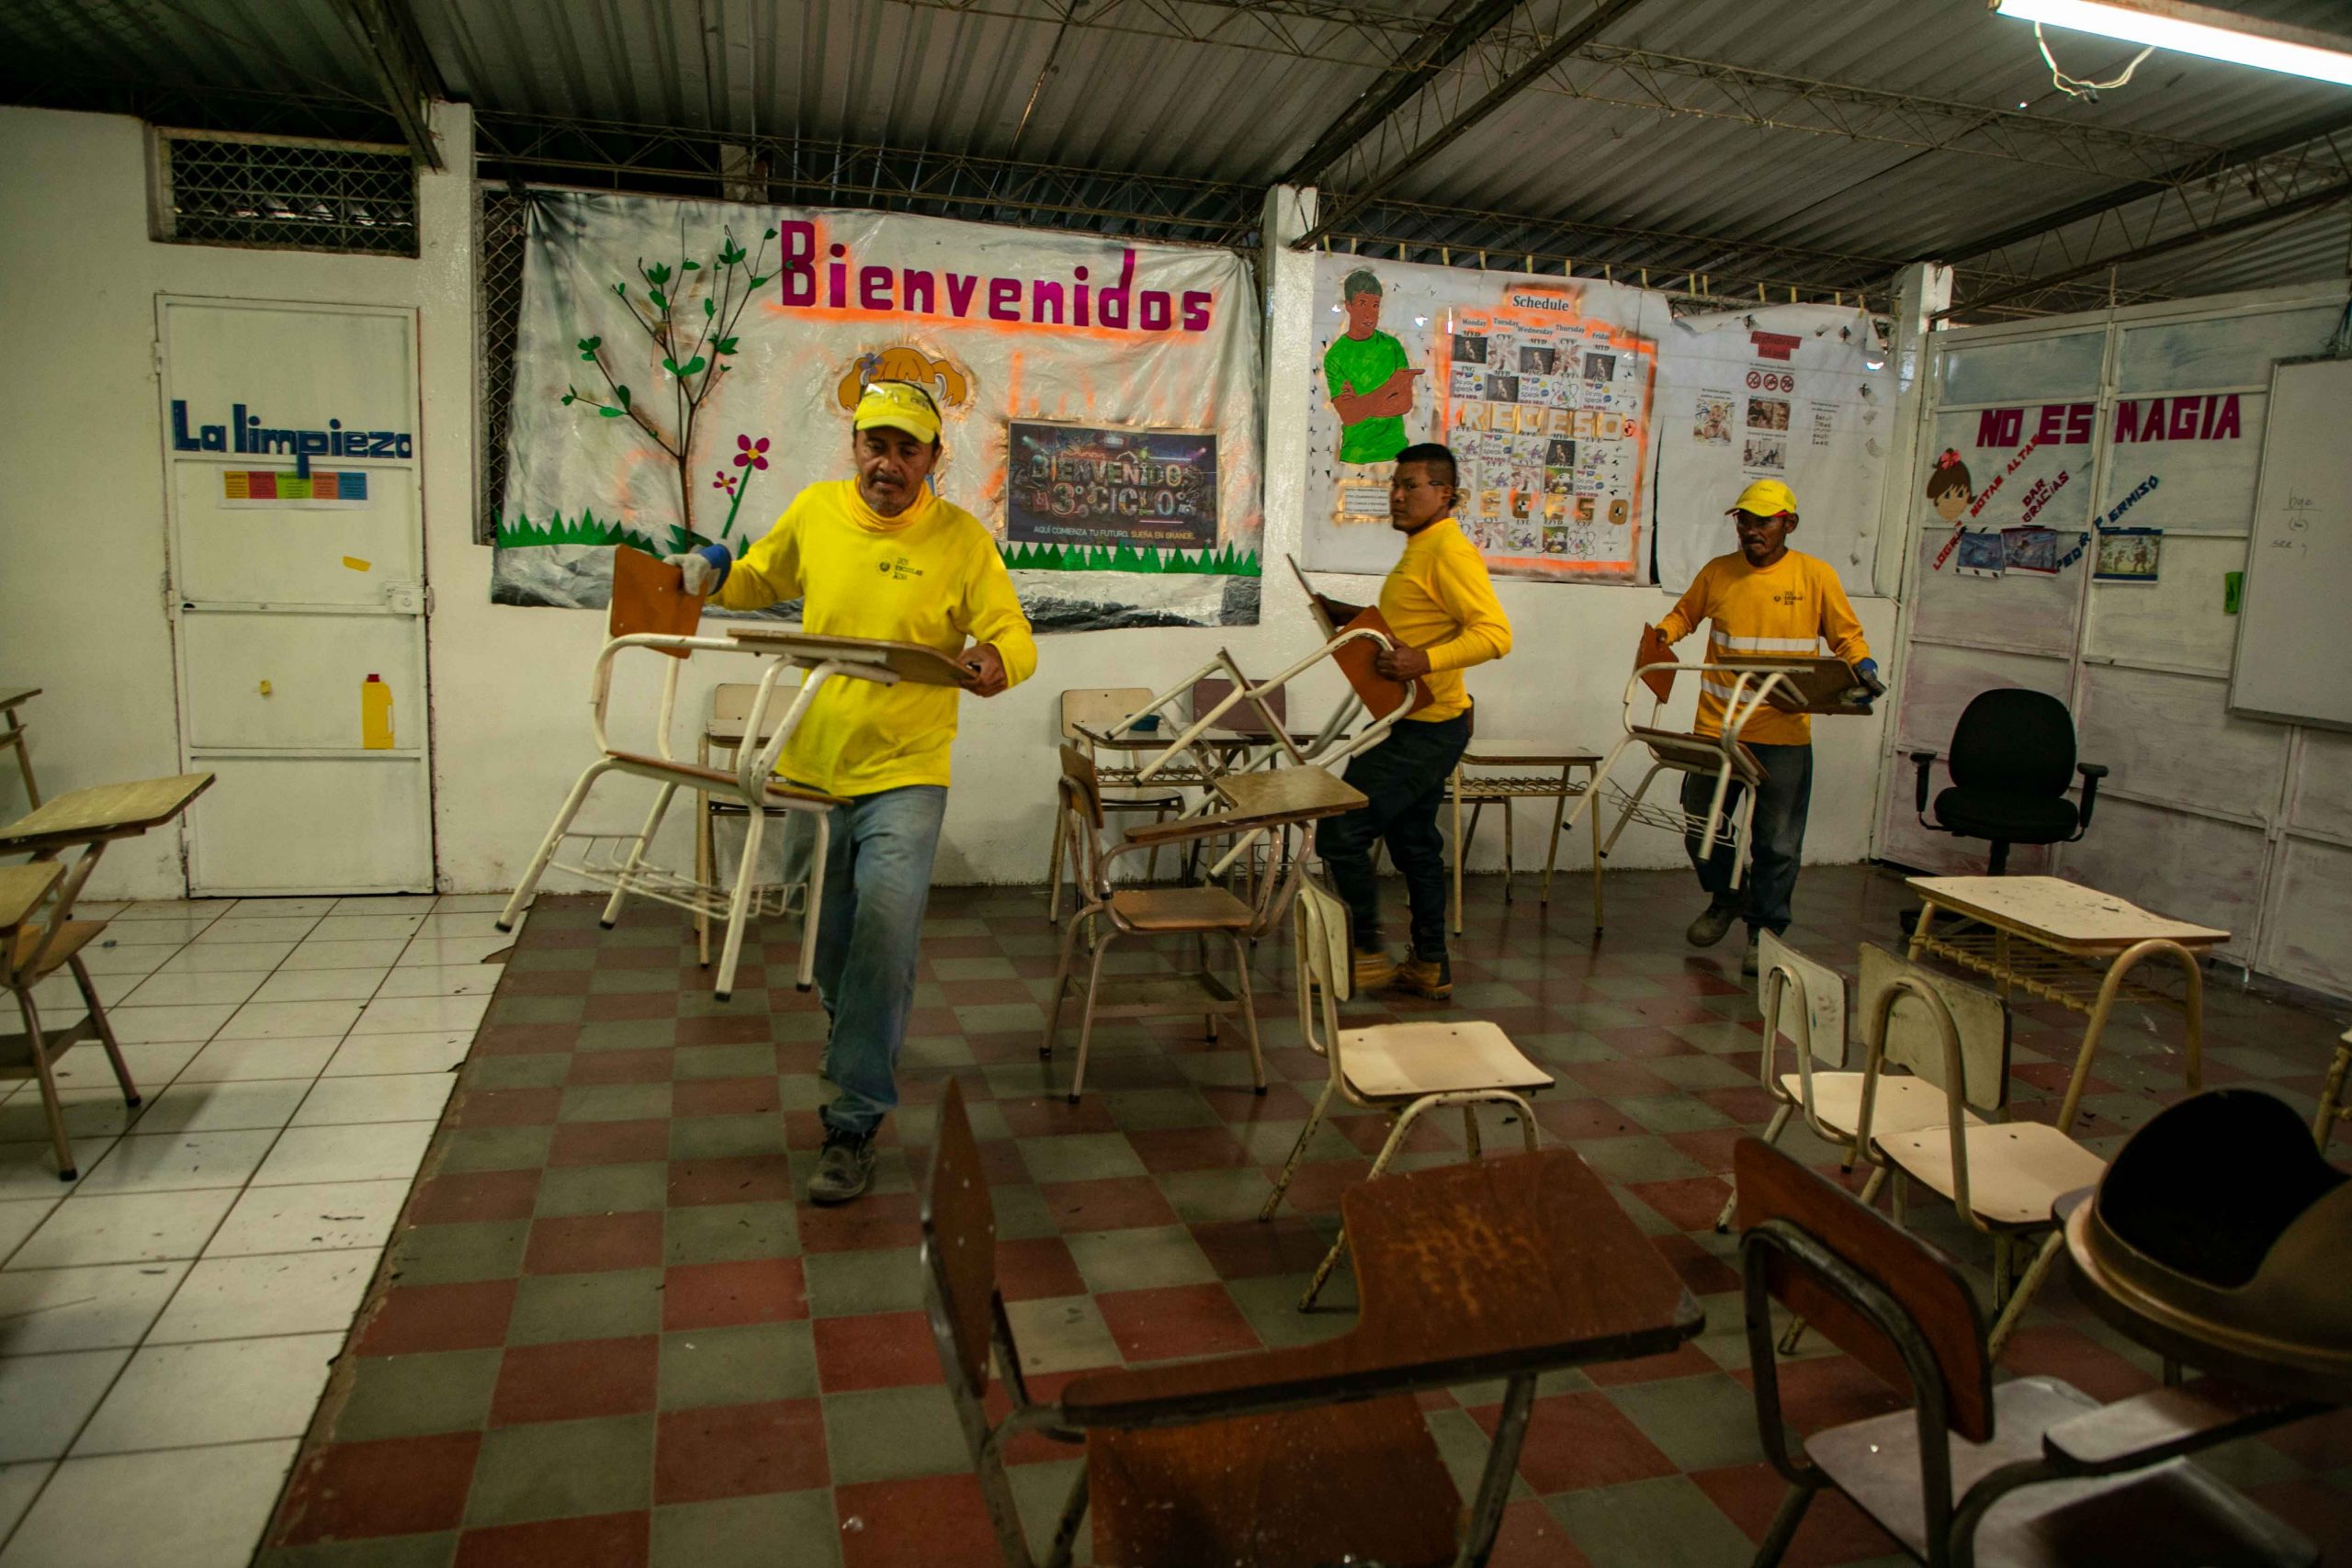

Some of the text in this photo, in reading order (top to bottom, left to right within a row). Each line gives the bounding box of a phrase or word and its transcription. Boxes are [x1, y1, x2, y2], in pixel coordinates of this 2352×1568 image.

[781, 220, 1213, 332] Bienvenidos
[1512, 295, 1570, 312] Schedule
[1462, 318, 1487, 328] Monday
[1493, 317, 1519, 327] Tuesday
[1517, 325, 1554, 336] Wednesday
[1555, 323, 1585, 334] Thursday
[1464, 401, 1624, 441] RECESO
[1976, 395, 2240, 447] NO ES MAGIA
[171, 400, 413, 479] La limpieza
[1032, 455, 1204, 488] BIENVENIDOS
[1453, 488, 1629, 526] RECESO
[2022, 478, 2045, 507] DAR
[2022, 469, 2069, 522] GRACIAS
[1034, 525, 1051, 535] AQUÍ
[1052, 526, 1088, 536] COMIENZA
[1089, 529, 1100, 537] TU
[1100, 529, 1129, 538] FUTURO.
[1131, 530, 1153, 538] SUEÑA
[1166, 531, 1195, 540] GRANDE.
